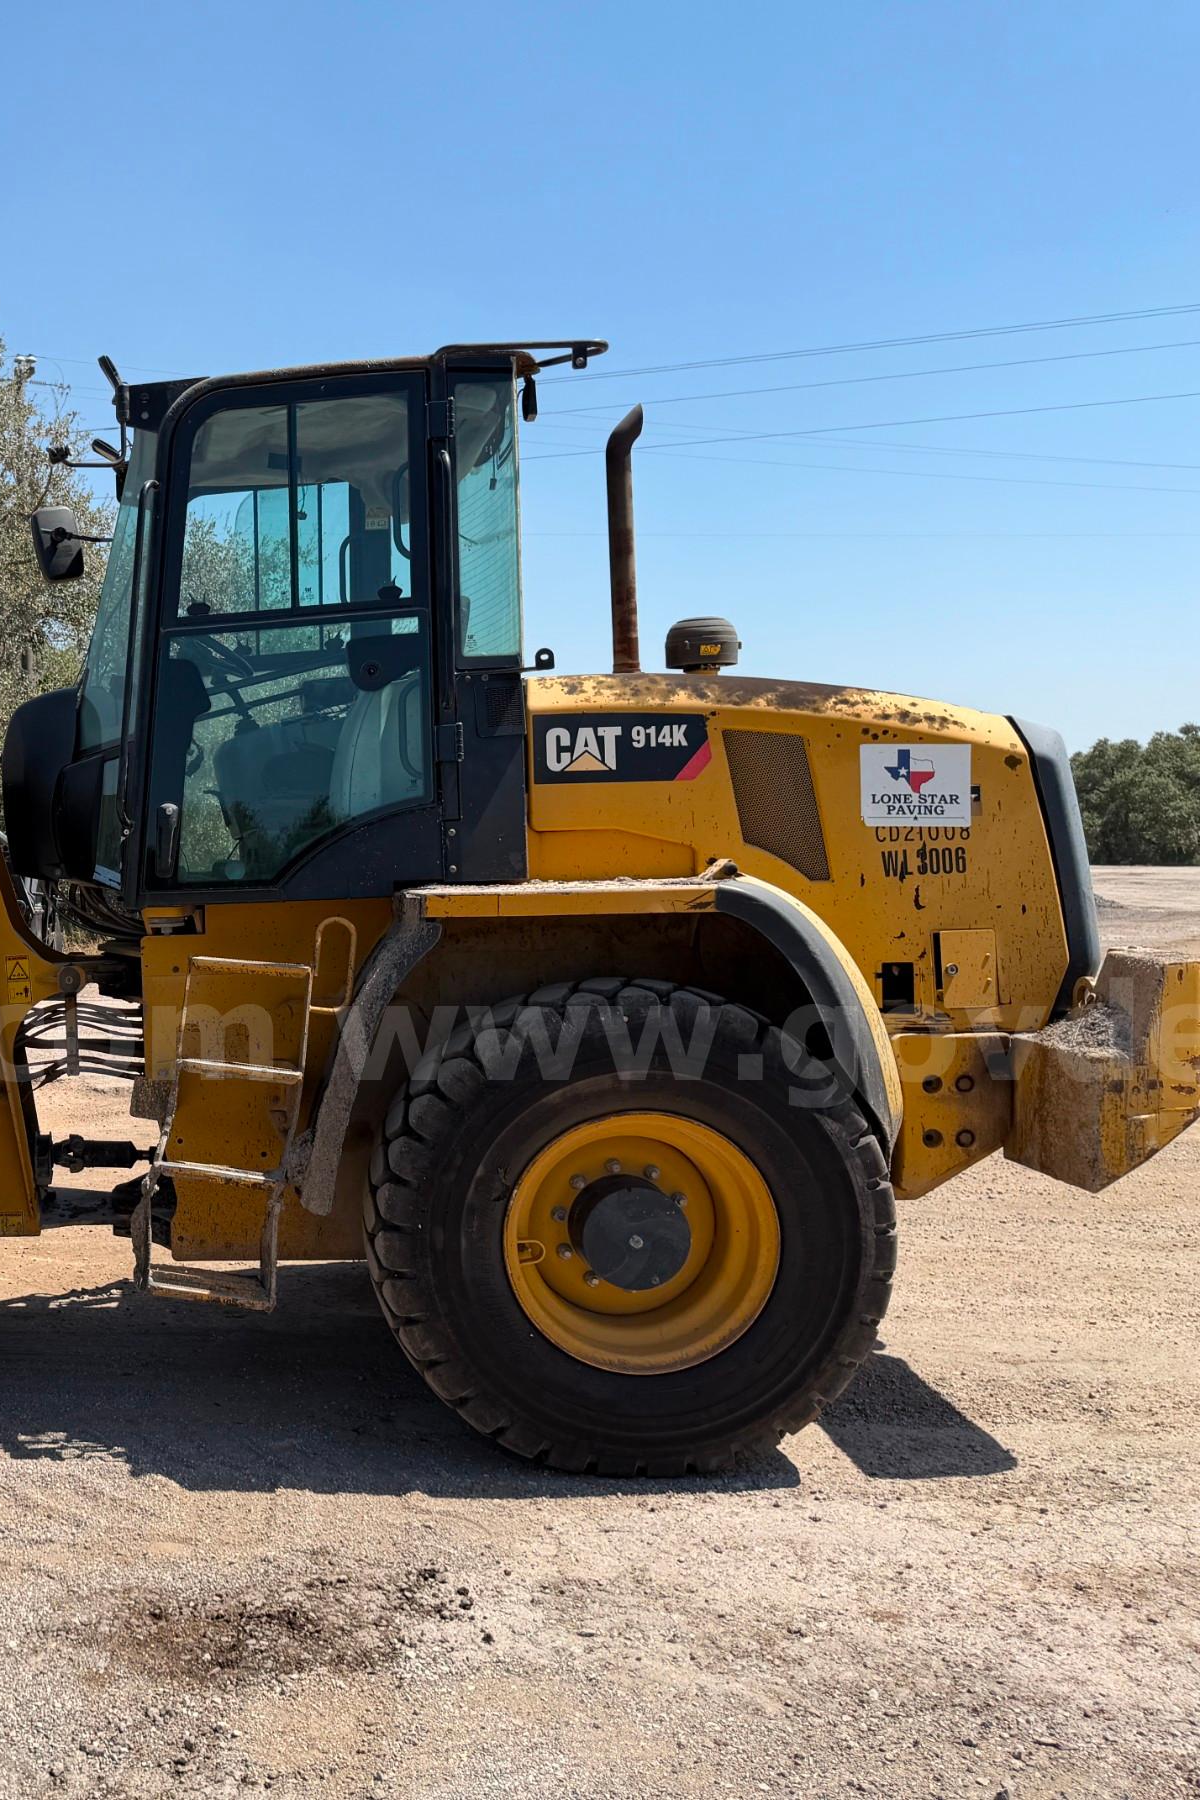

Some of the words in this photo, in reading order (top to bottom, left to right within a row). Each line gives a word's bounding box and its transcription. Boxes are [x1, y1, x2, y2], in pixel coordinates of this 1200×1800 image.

[545, 726, 622, 772] CAT
[631, 724, 688, 748] 914K
[871, 794, 913, 804] LONE
[918, 794, 960, 804] STAR
[886, 805, 945, 815] PAVING
